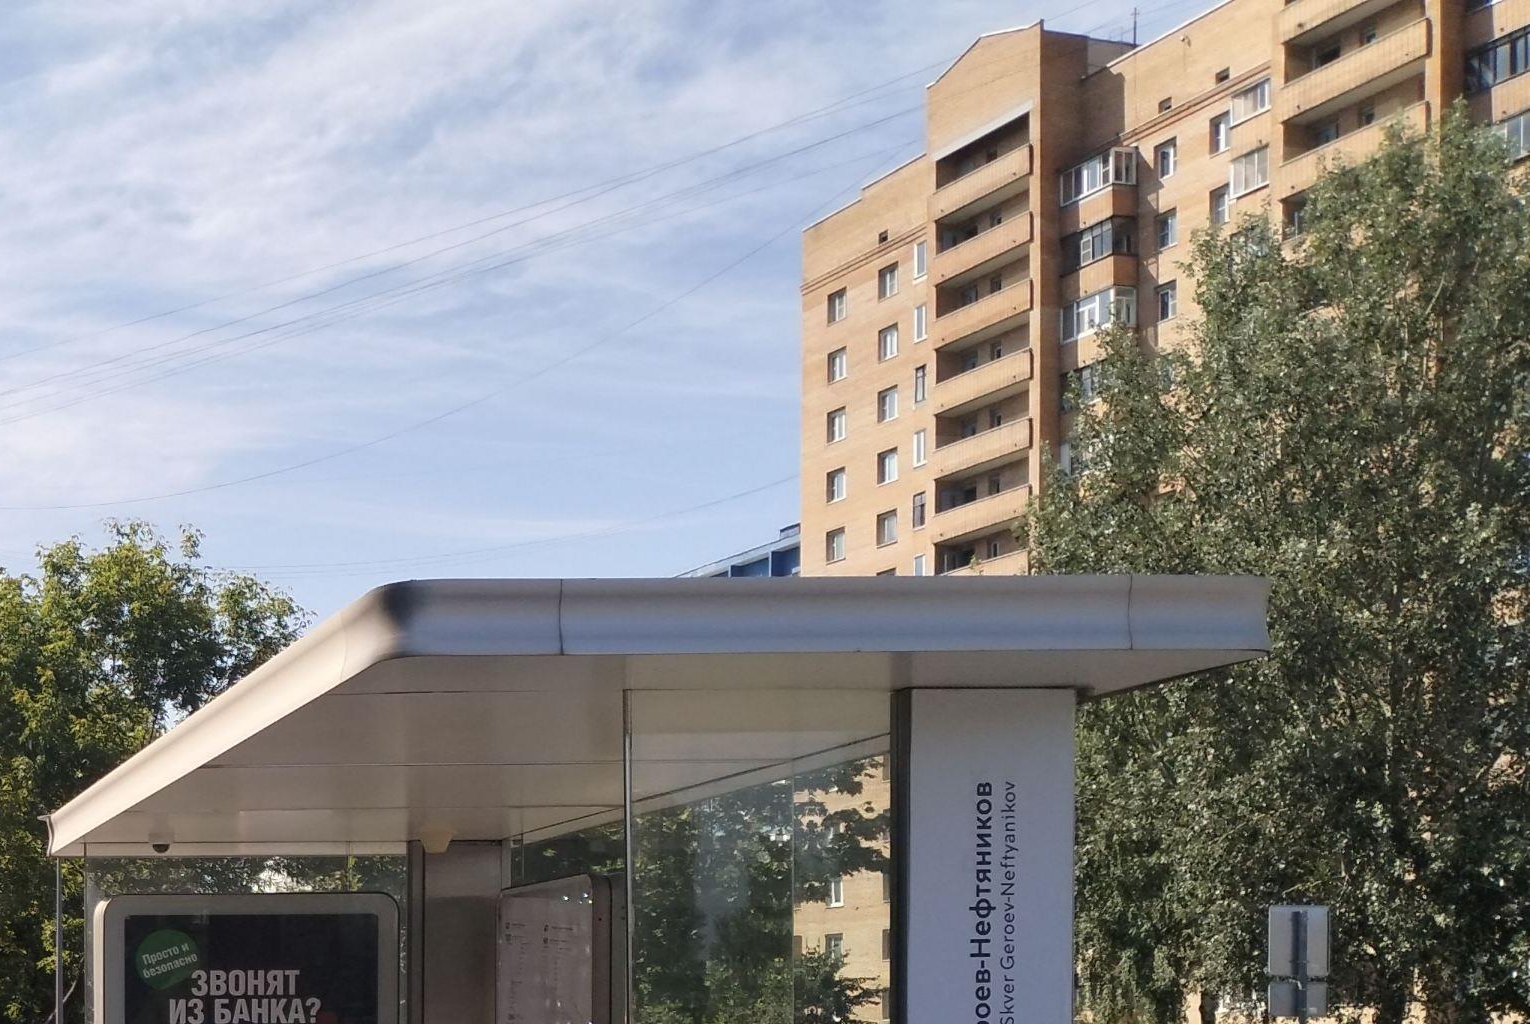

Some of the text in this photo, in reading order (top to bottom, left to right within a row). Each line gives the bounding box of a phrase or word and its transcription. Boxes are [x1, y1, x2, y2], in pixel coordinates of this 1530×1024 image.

[1000, 781, 1019, 969] Geroev-Neftyanikov
[142, 943, 190, 965] Просто и
[143, 953, 198, 978] безопасно
[191, 969, 301, 997] ЗВОНЯТ
[170, 997, 322, 1024] ИЗ БАНКА?
